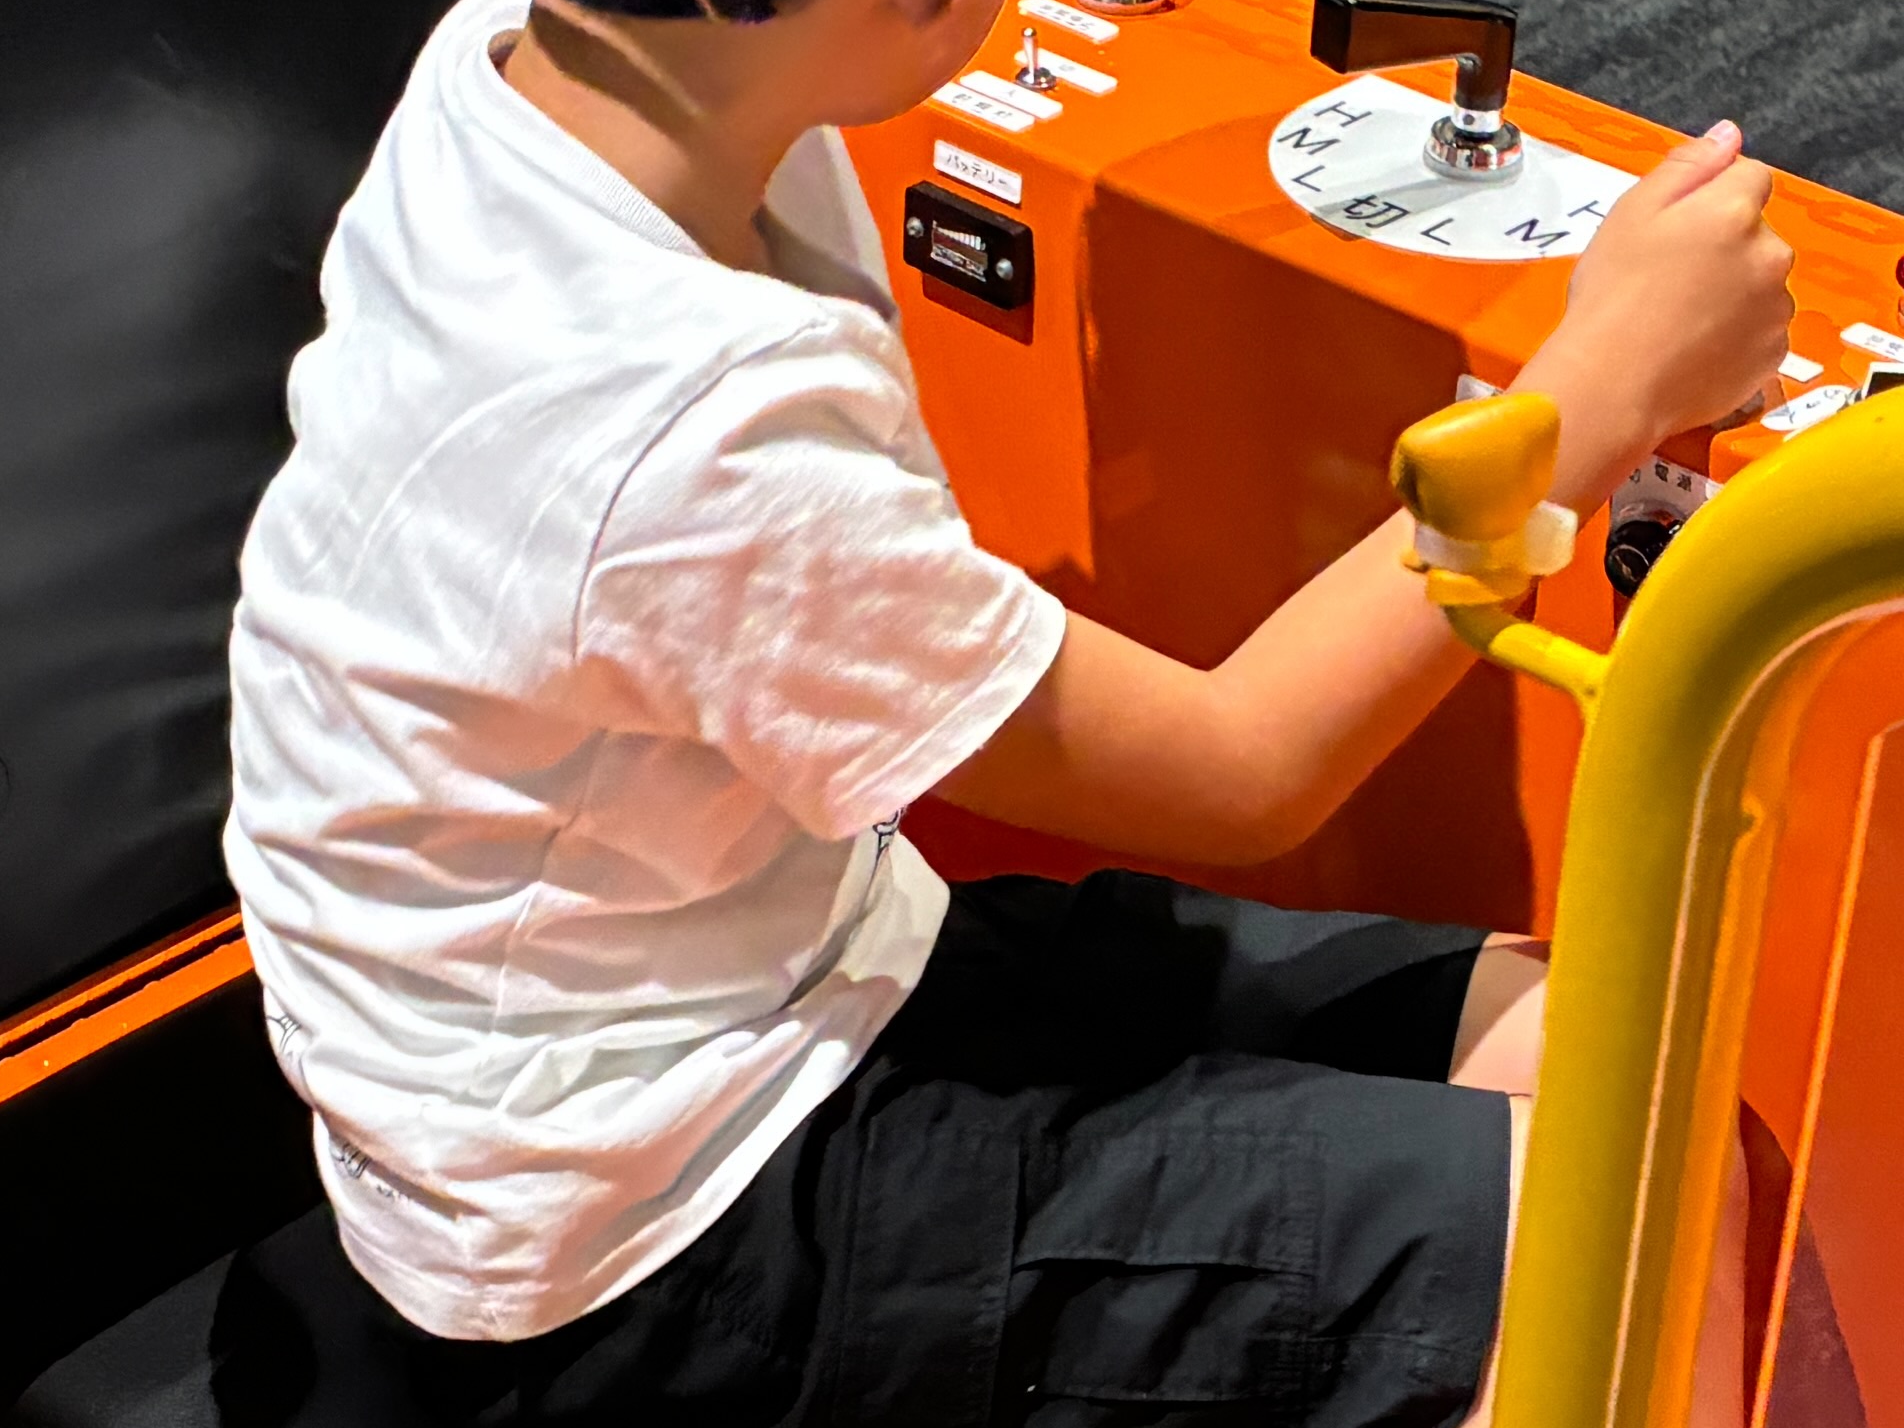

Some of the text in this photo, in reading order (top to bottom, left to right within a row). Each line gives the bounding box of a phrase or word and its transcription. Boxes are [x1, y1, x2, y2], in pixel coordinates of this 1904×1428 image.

[1313, 100, 1372, 127] H
[1277, 127, 1341, 155] M
[1291, 165, 1326, 192] L
[1343, 194, 1410, 228] 切
[1419, 217, 1454, 246] L
[1504, 217, 1571, 249] M
